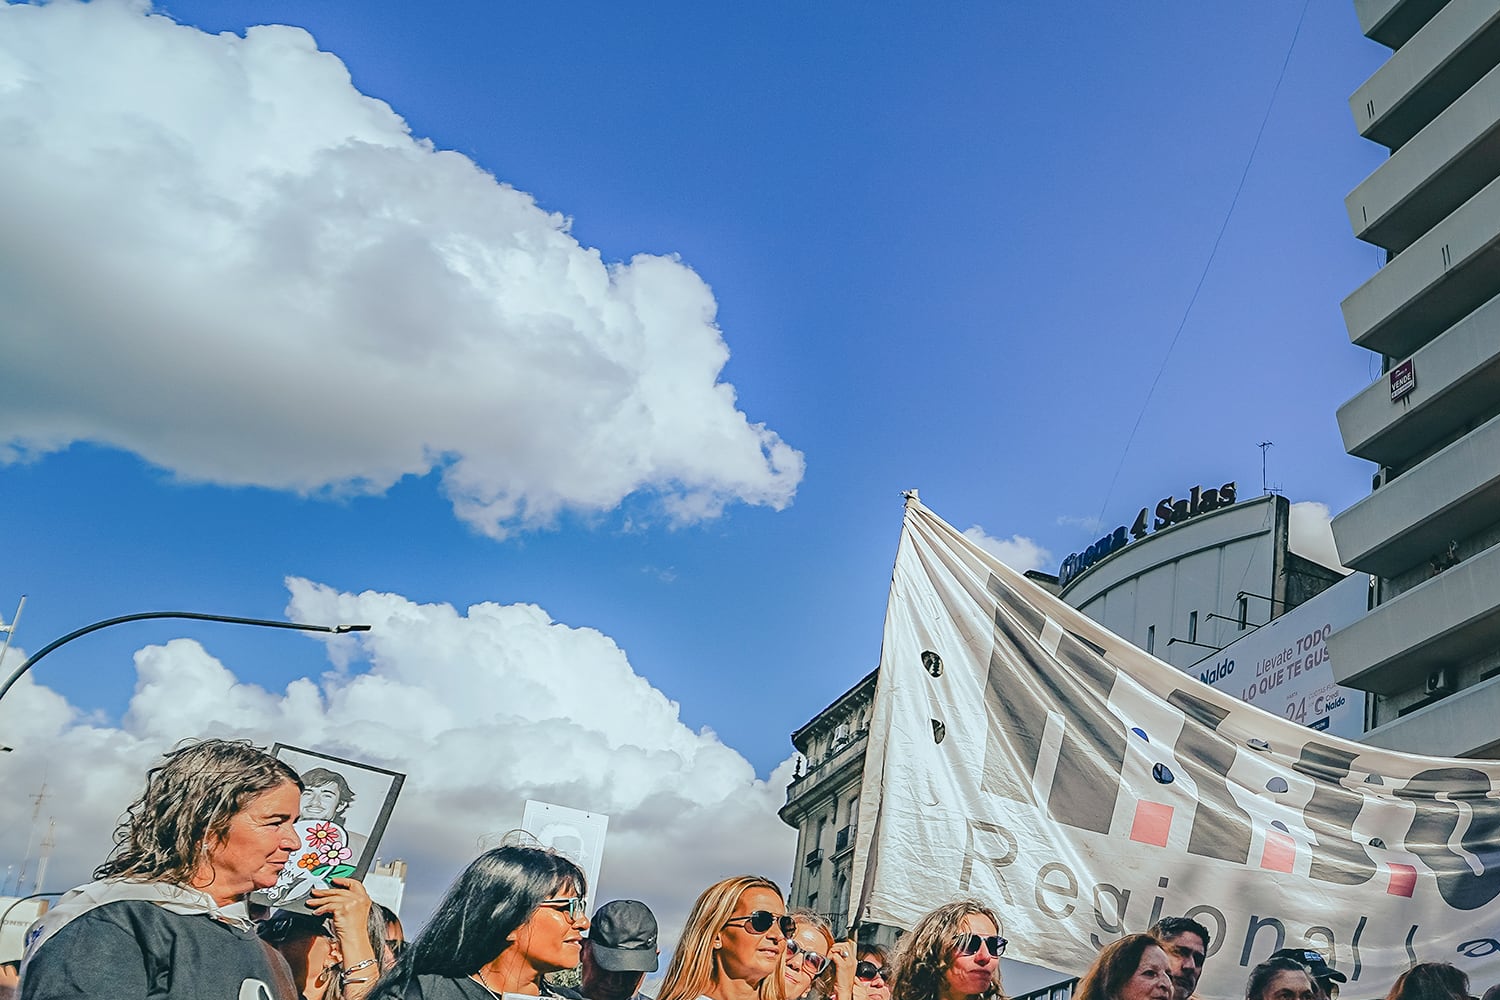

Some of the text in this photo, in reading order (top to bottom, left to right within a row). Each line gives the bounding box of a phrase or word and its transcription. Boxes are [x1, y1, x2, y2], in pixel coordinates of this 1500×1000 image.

[1391, 372, 1411, 390] VENDE
[1130, 507, 1149, 540] 4
[1154, 481, 1237, 531] Salas
[1256, 624, 1331, 678] Llevate TODO
[1200, 658, 1235, 685] Naldo
[1241, 645, 1330, 702] LO QUE TE GUS
[1286, 697, 1307, 724] 24
[1325, 697, 1346, 713] Naldo
